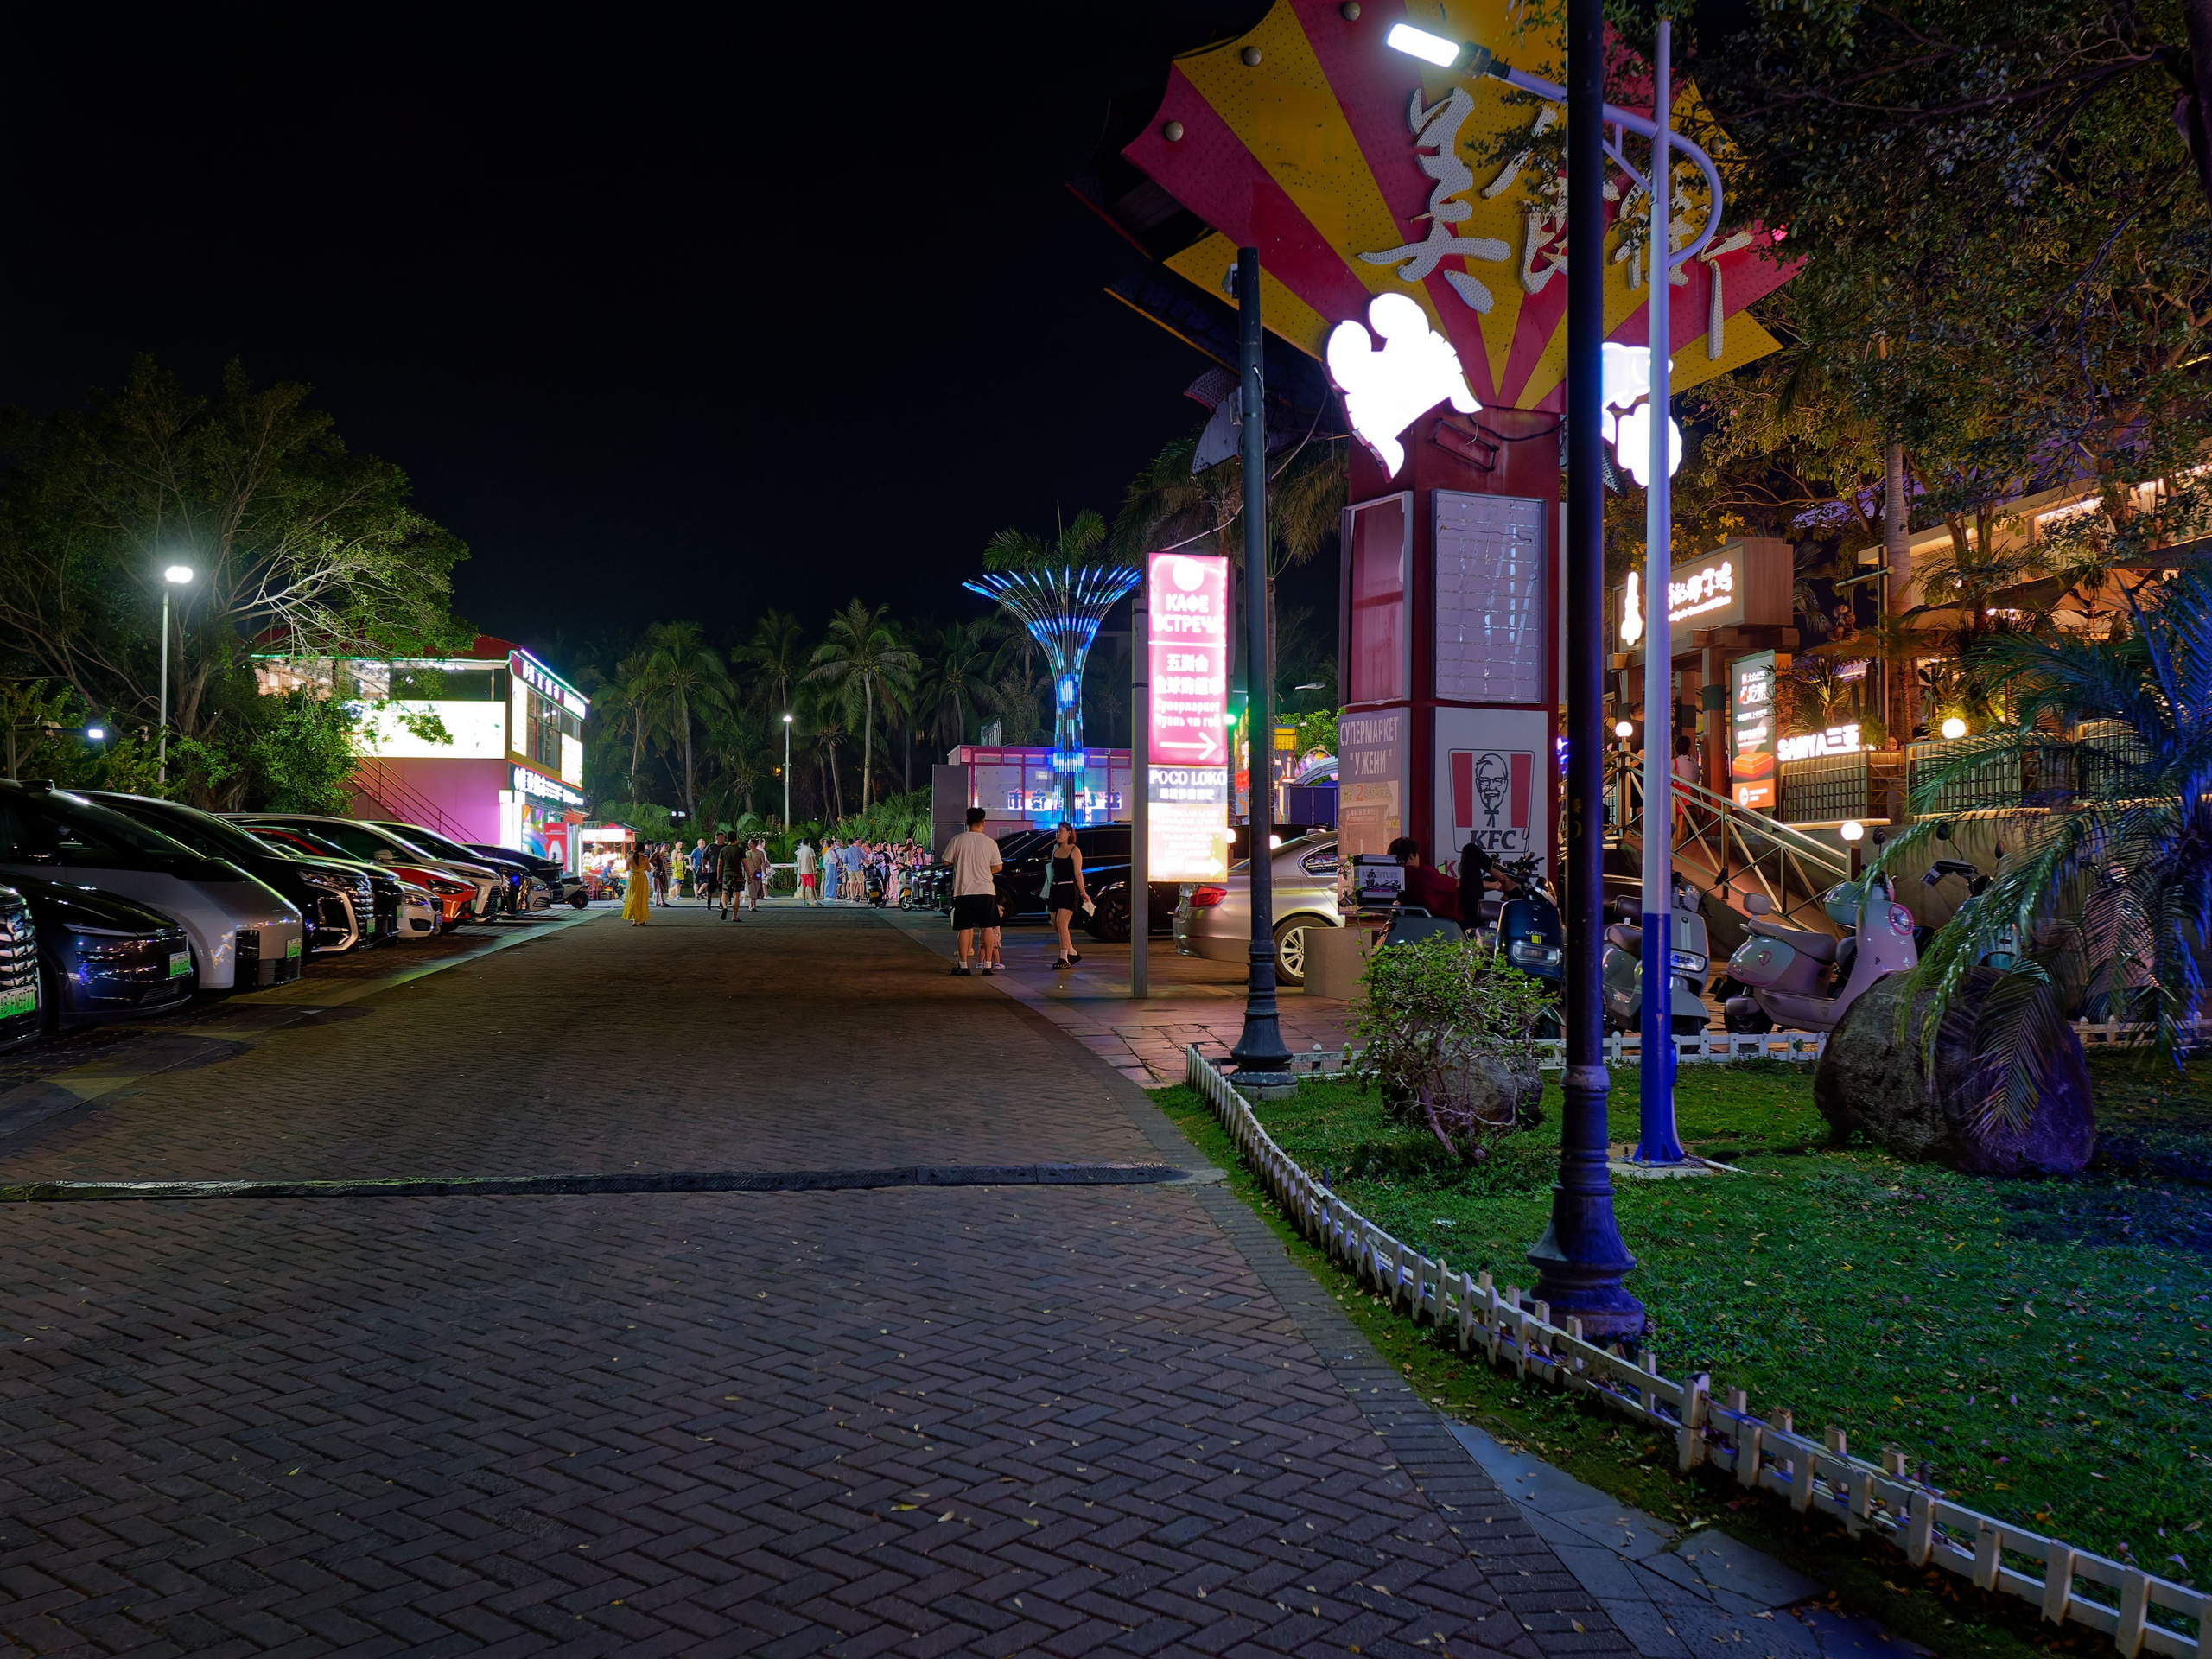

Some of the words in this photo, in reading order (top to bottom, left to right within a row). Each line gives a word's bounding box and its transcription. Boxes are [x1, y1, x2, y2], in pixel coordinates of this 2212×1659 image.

[1166, 594, 1209, 613] КАФЕ
[1340, 717, 1399, 746] СУПЕРМАРКЕТ
[1149, 770, 1188, 785] POCO
[1191, 771, 1227, 785] LOKO
[1356, 785, 1363, 802] 2
[1385, 820, 1400, 830] ВХОД
[1470, 830, 1516, 850] KFC
